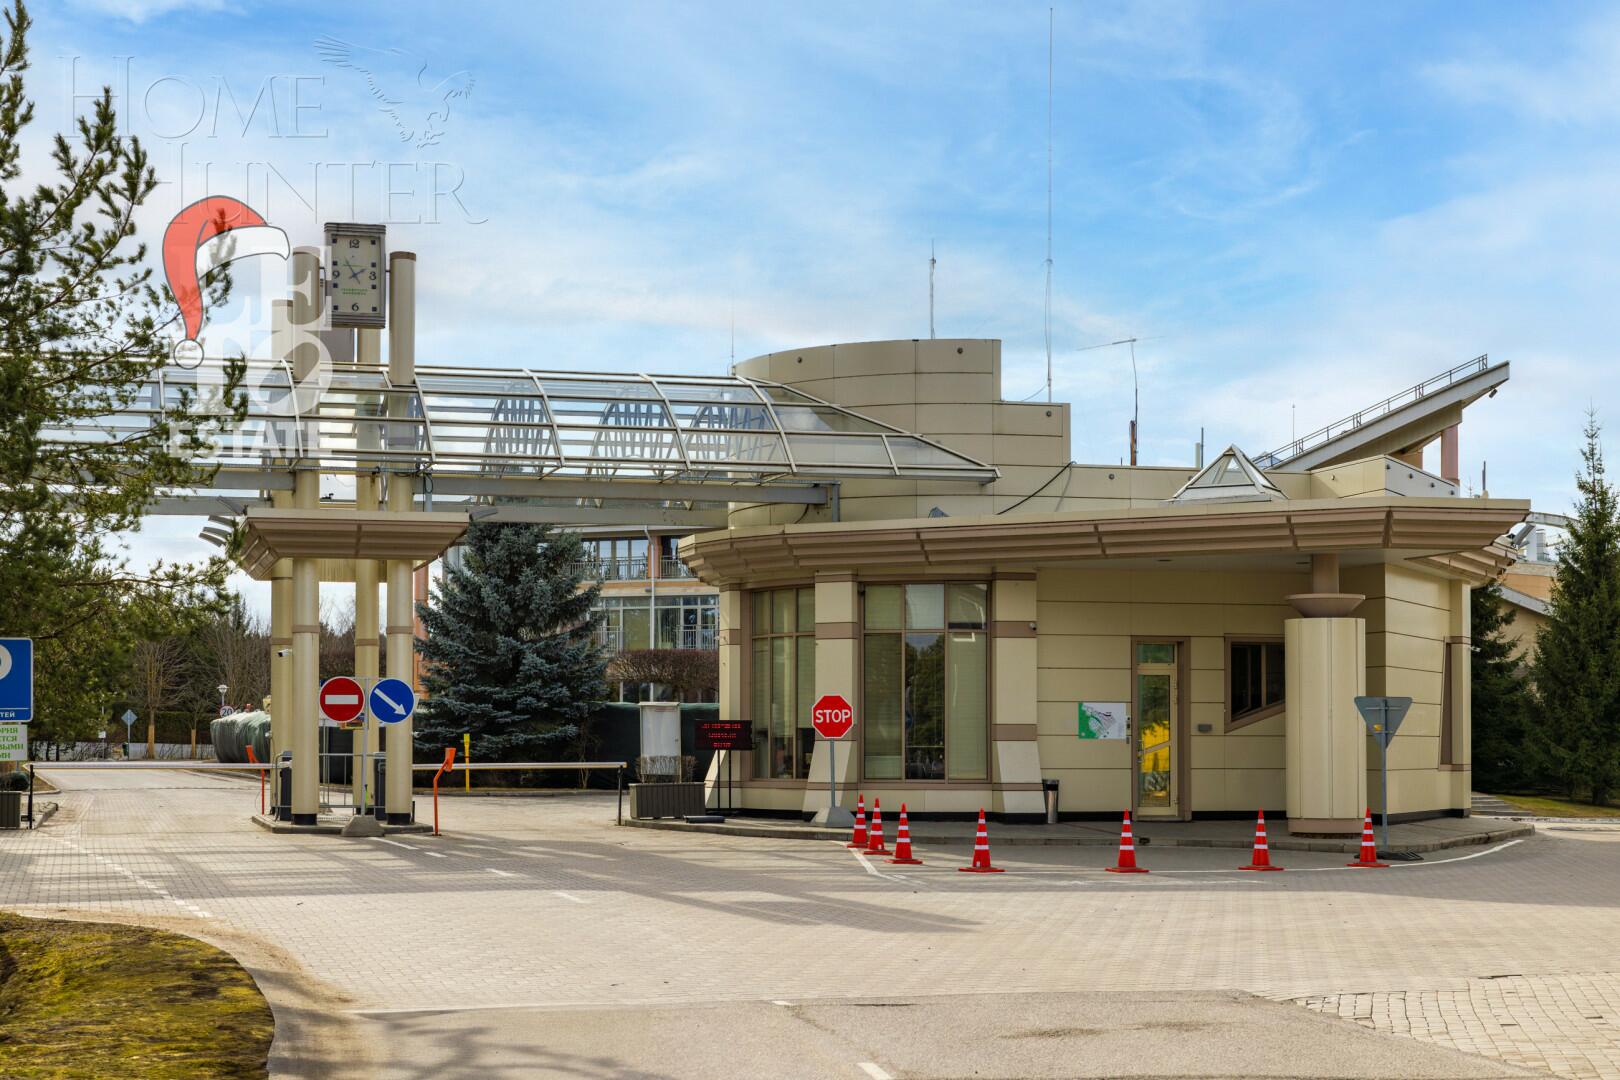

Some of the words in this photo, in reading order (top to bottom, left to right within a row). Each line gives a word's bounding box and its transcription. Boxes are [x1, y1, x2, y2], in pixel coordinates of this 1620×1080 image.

[350, 238, 360, 249] 12
[332, 270, 340, 278] 9
[369, 271, 376, 280] 3
[352, 303, 359, 312] 6
[815, 708, 851, 724] STOP
